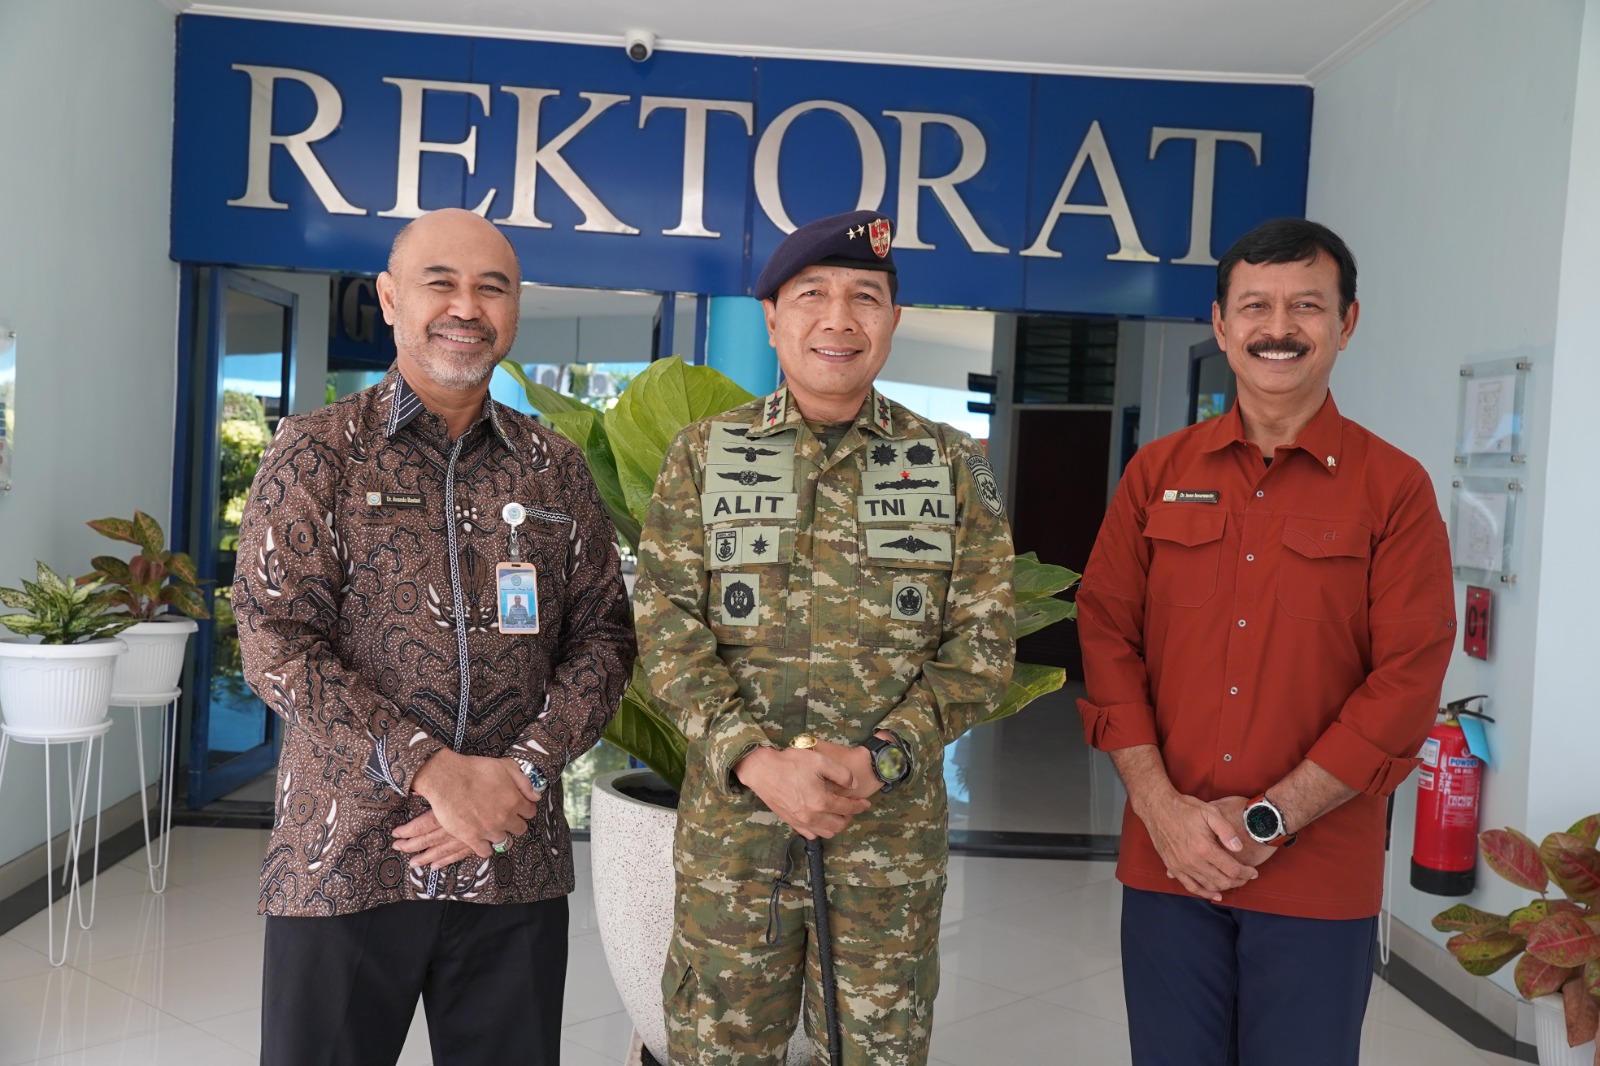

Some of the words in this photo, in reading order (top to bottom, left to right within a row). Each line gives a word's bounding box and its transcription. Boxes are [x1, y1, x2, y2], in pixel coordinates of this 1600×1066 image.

[227, 64, 1262, 265] REKTORAT
[713, 496, 784, 517] ALIT
[865, 498, 906, 517] TNI
[919, 498, 950, 519] AL
[1468, 605, 1486, 640] 01
